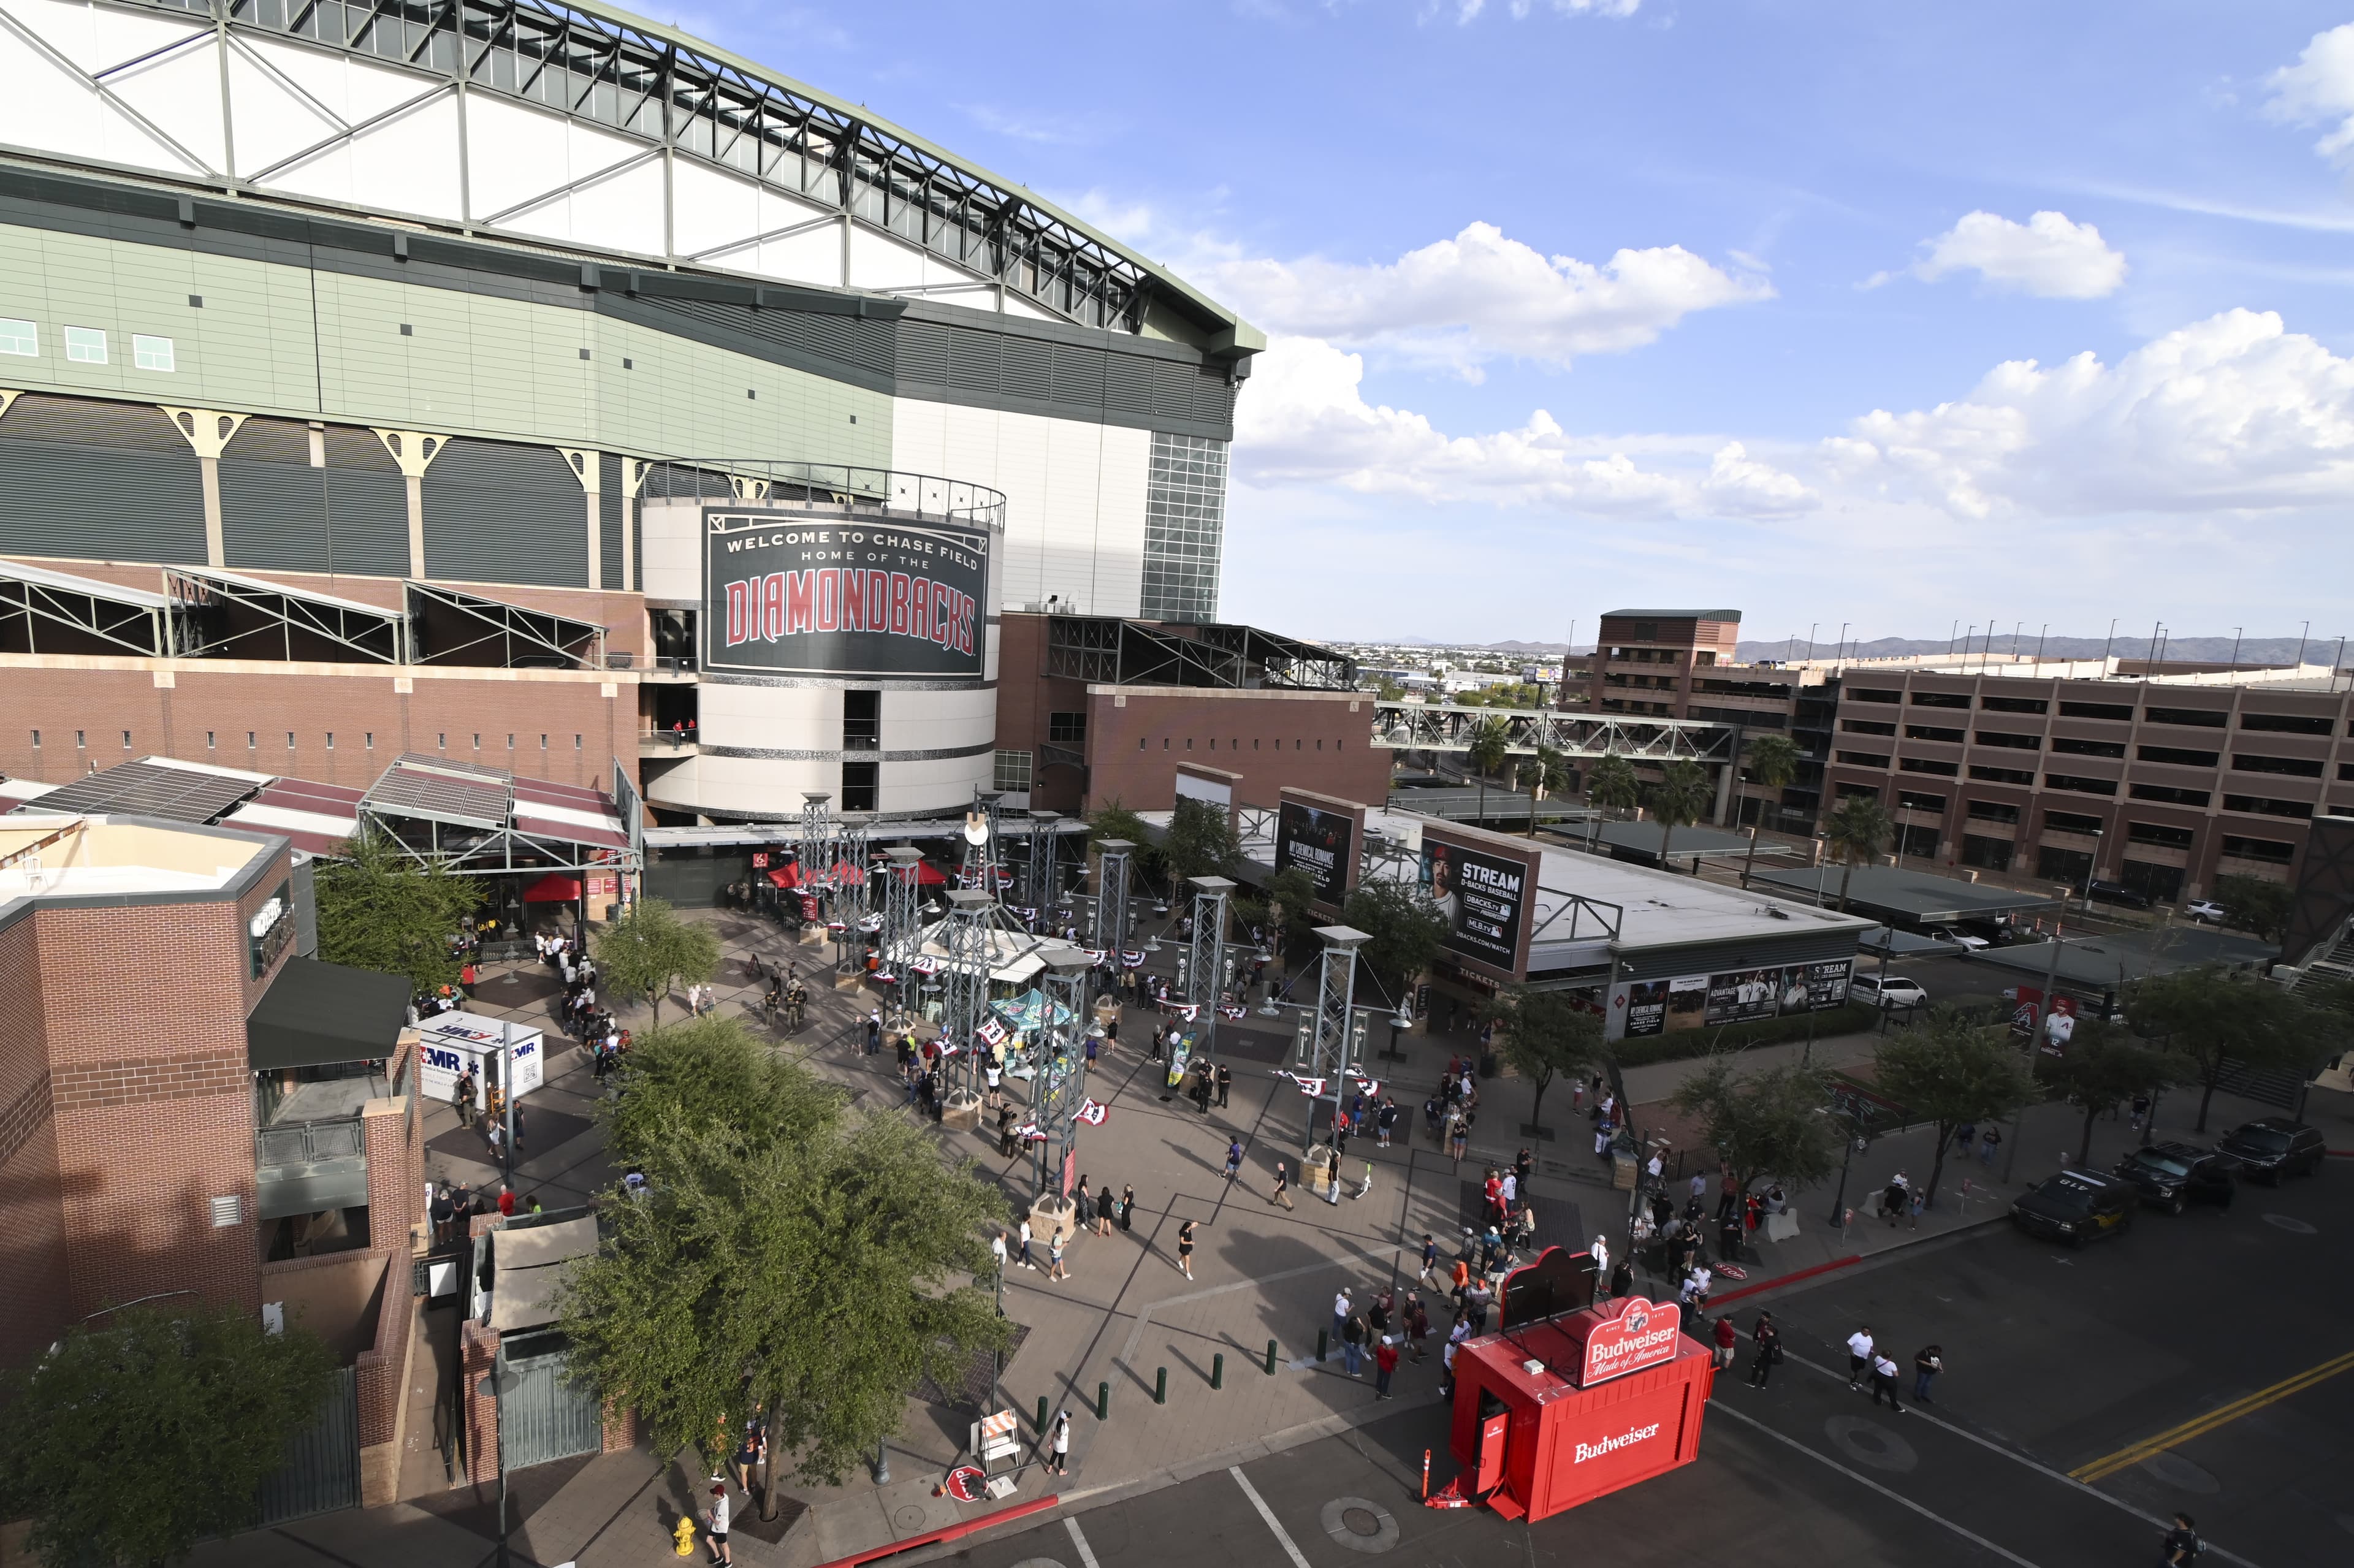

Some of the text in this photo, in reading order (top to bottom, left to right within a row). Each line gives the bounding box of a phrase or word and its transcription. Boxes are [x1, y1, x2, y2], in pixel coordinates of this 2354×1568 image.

[727, 531, 978, 571] WELCOME TO CHASE FIELD
[801, 551, 929, 569] HOME OF THE
[724, 568, 975, 657] DIAMONDBACKS
[1289, 840, 1335, 866] MY CHEMICAL ROMANCE
[1463, 862, 1520, 892] STREAM
[1461, 878, 1518, 901] D-BACKS BASEBALL
[1466, 895, 1499, 911] DBACKS.TV
[1306, 908, 1335, 923] TICKETS
[1468, 919, 1491, 932] MLB.TV
[1456, 931, 1510, 954] DBACKS.COM/WATCH
[1460, 967, 1500, 988] TICKETS
[1815, 963, 1847, 974] SREAM
[1710, 988, 1737, 997] ADVANTAGE
[2051, 1038, 2059, 1046] 12
[1716, 1264, 1743, 1278] STOP
[1586, 1344, 1670, 1378] Made of America
[1574, 1423, 1659, 1464] Budweiser
